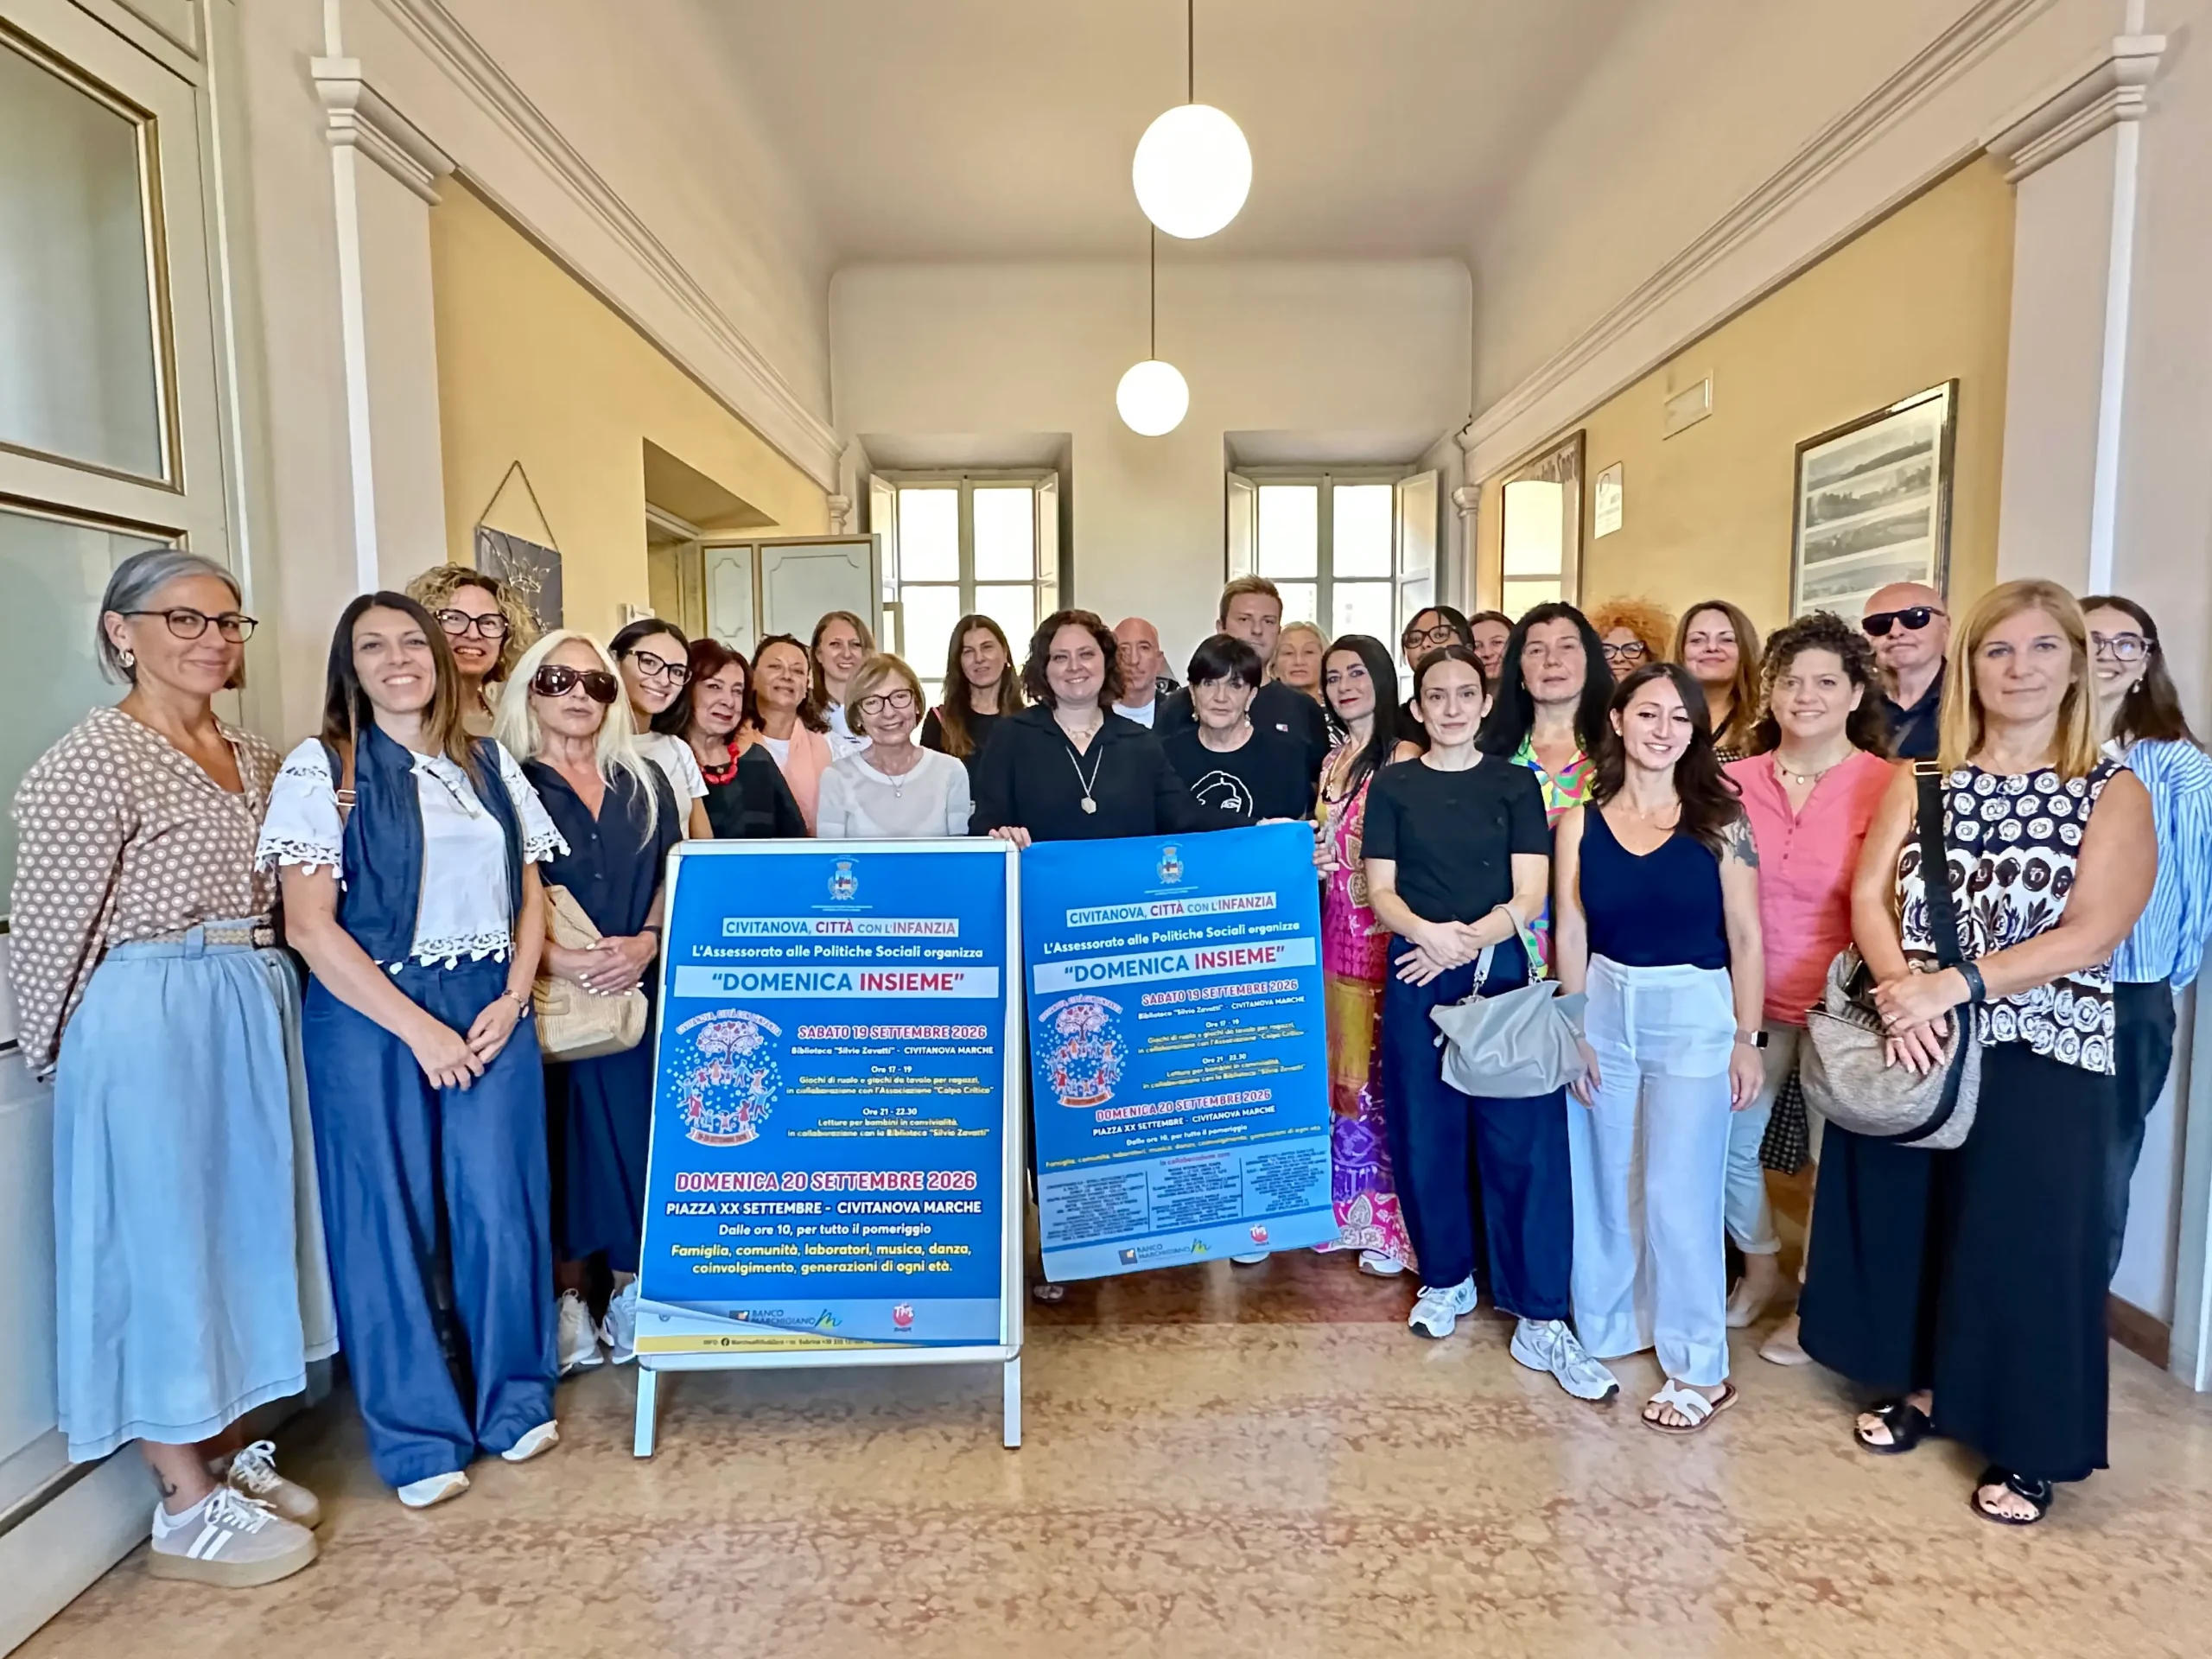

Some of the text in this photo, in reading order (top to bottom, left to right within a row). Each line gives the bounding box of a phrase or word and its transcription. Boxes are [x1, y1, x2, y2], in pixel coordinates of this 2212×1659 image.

[1070, 895, 1274, 925] CIVITANOVA, CITTÀ CON L'INFANZIA
[726, 918, 956, 935] CIVITANOVA, CITTÀ CON L'INFANZIA
[1044, 920, 1300, 955] L'Assessorato alle Politiche Sociali organizza
[692, 944, 983, 960] L'Assessorato alle Politiche Sociali organizza
[1141, 979, 1299, 1007] SABATO 19 SETTEMBRE 2026
[798, 1026, 987, 1039] SABATO 19 SETTEMBRE 2026
[1096, 1089, 1272, 1122] DOMENICA 20 SETTEMBRE 2026
[1092, 1126, 1122, 1137] PIAZZA
[1123, 1123, 1136, 1132] XX
[1137, 1116, 1185, 1131] SETTEMBRE
[1192, 1109, 1242, 1123] CIVITANOVA
[676, 1171, 977, 1192] DOMENICA 20 SETTEMBRE 2026
[666, 1203, 717, 1215] PIAZZA
[720, 1202, 740, 1215] XX
[743, 1202, 822, 1215] SETTEMBRE
[836, 1201, 921, 1214] CIVITANOVA
[924, 1200, 982, 1213] MARCHE
[719, 1224, 751, 1236] Dalle
[777, 1224, 793, 1236] 10,
[797, 1226, 817, 1237] per
[819, 1224, 849, 1235] tutto
[852, 1223, 860, 1234] il
[862, 1223, 931, 1237] pomeriggio
[671, 1242, 971, 1259] Famiglia, comunità, laboratori, musica, danza,
[692, 1260, 952, 1276] coinvolgimento, generazioni di ogni età.
[752, 1309, 785, 1318] BANCO
